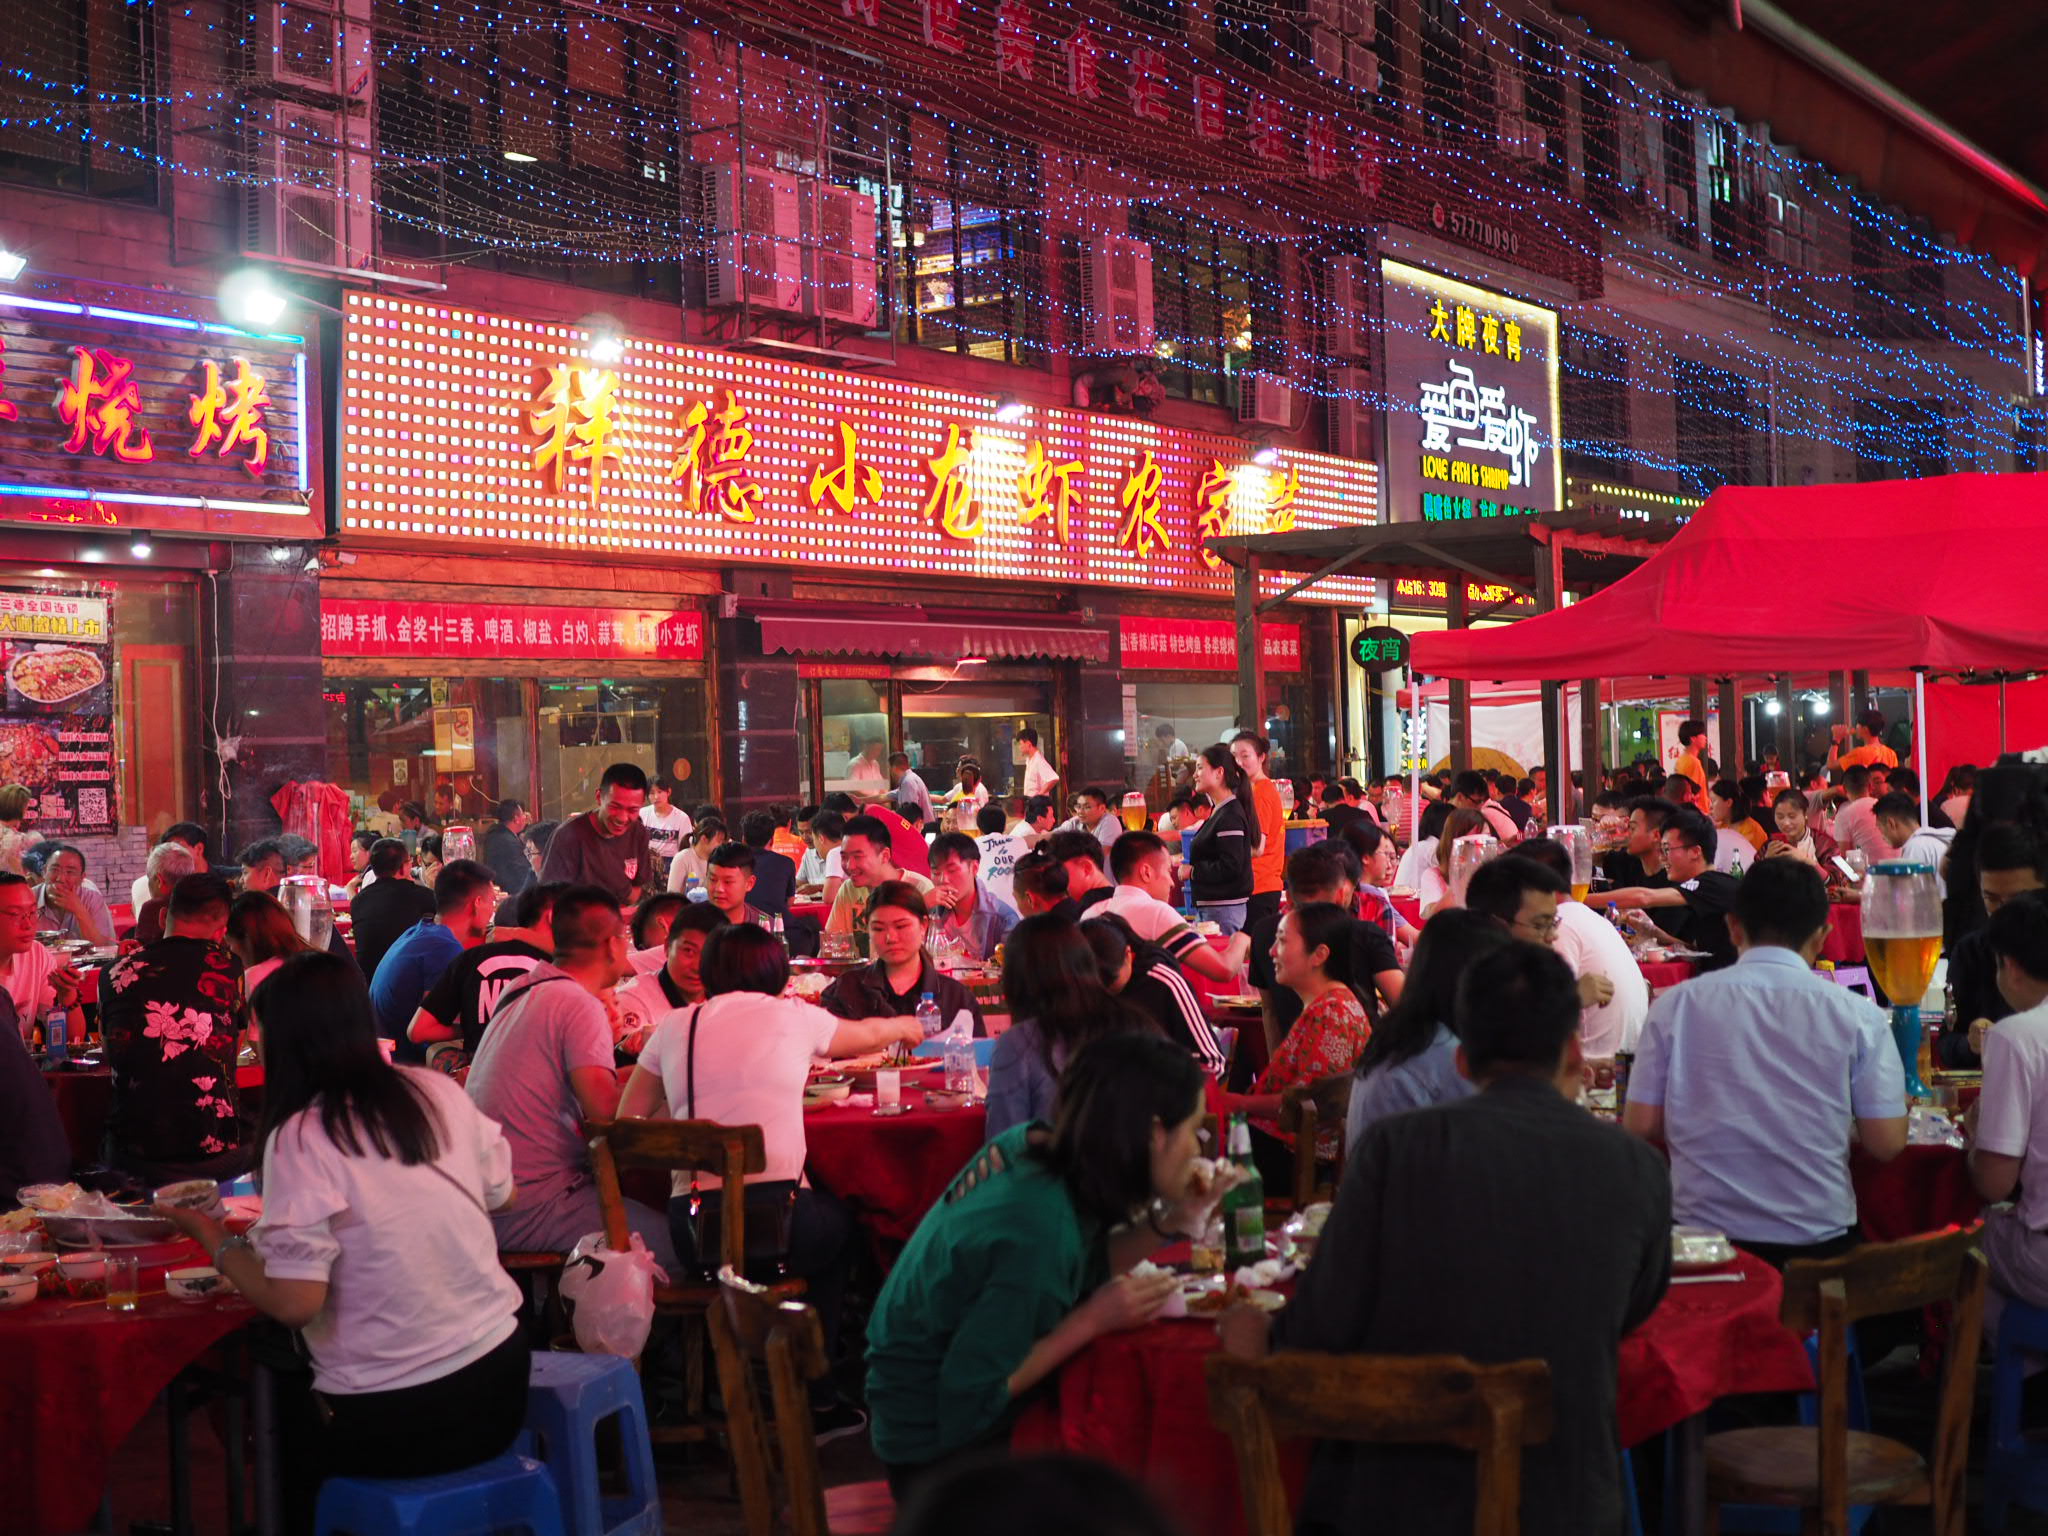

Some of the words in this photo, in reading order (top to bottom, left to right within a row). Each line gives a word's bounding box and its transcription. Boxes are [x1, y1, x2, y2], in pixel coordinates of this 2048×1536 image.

[839, 0, 1384, 201] 色美食栏目组推荐
[1451, 211, 1519, 254] 57770090
[1430, 298, 1522, 363] 大牌夜宵
[0, 335, 271, 478] 烧烤
[1423, 455, 1449, 482] LOVE
[1451, 460, 1471, 485] FISH
[1471, 463, 1480, 486] &
[1358, 636, 1402, 662] 夜宵
[994, 855, 1015, 865] OUR
[478, 978, 512, 1024] N
